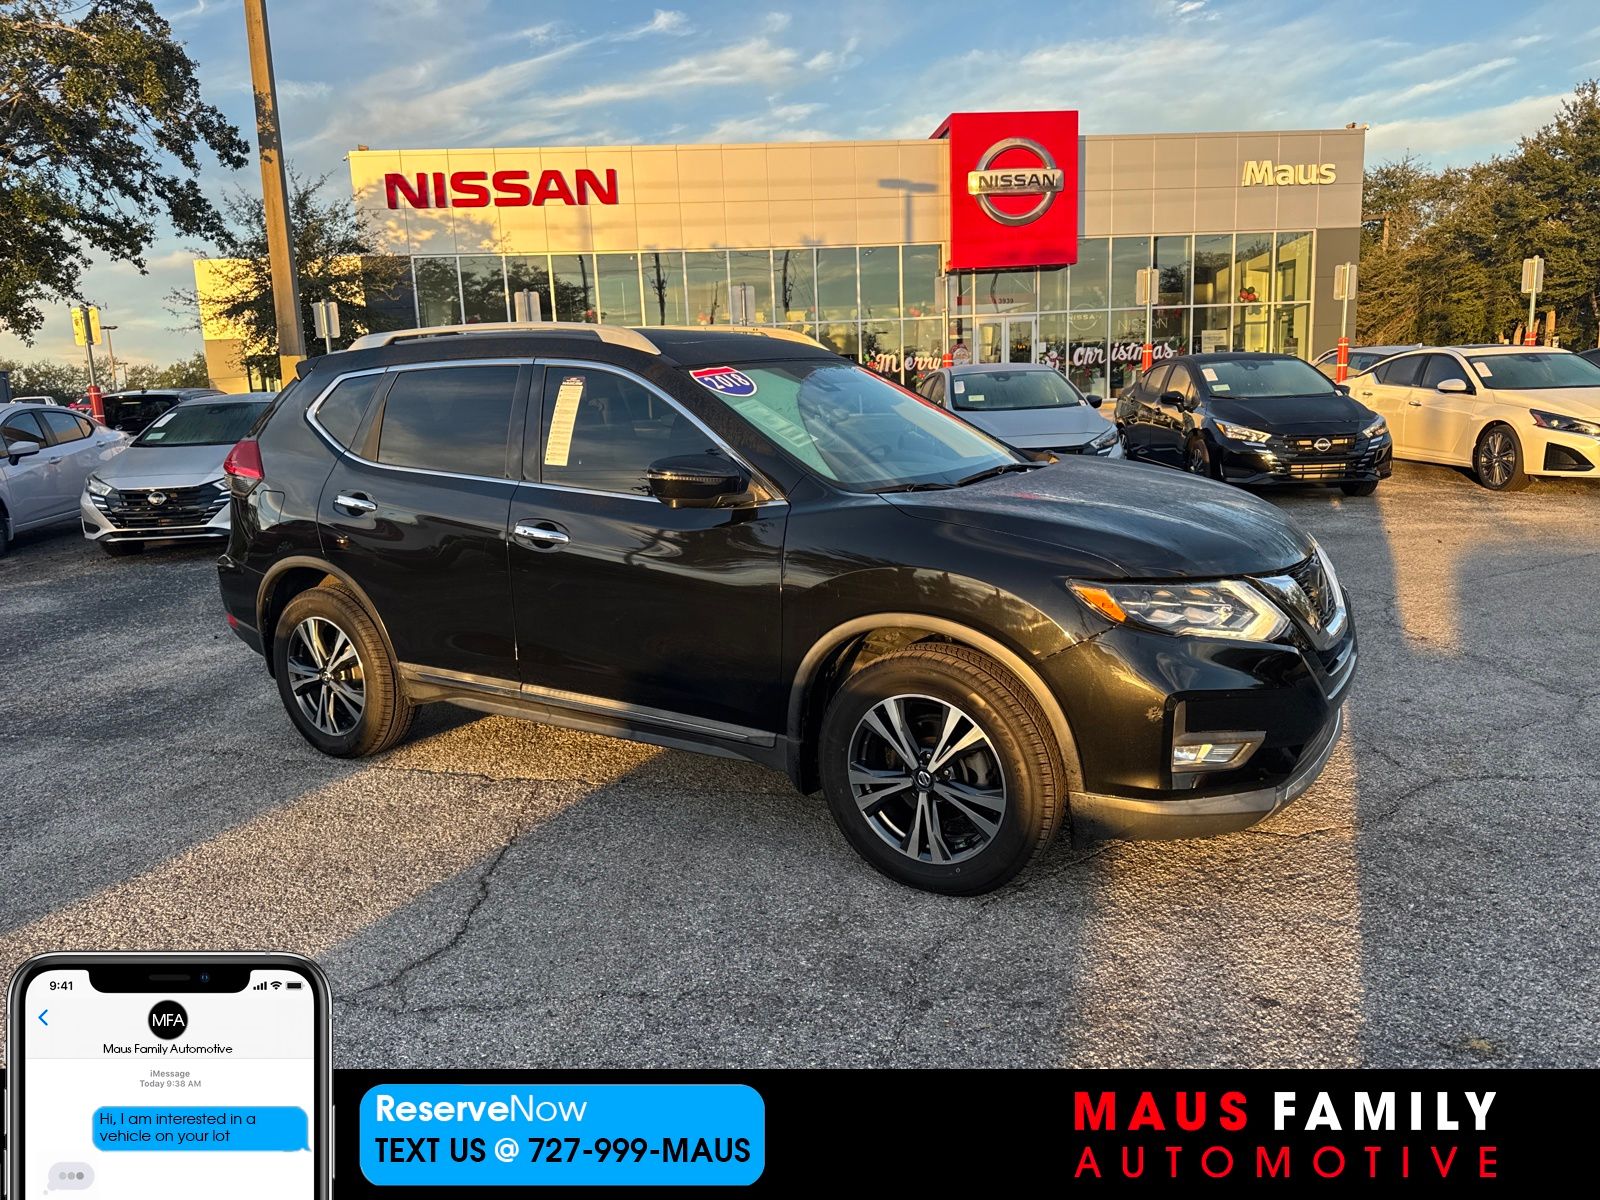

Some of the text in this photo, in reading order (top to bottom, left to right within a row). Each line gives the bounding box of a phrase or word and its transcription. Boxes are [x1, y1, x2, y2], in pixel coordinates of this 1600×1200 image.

[978, 173, 1056, 188] NISSAN
[1241, 159, 1337, 187] Maus
[384, 168, 619, 209] NISSAN
[876, 353, 942, 373] Merry
[704, 373, 751, 390] 2018
